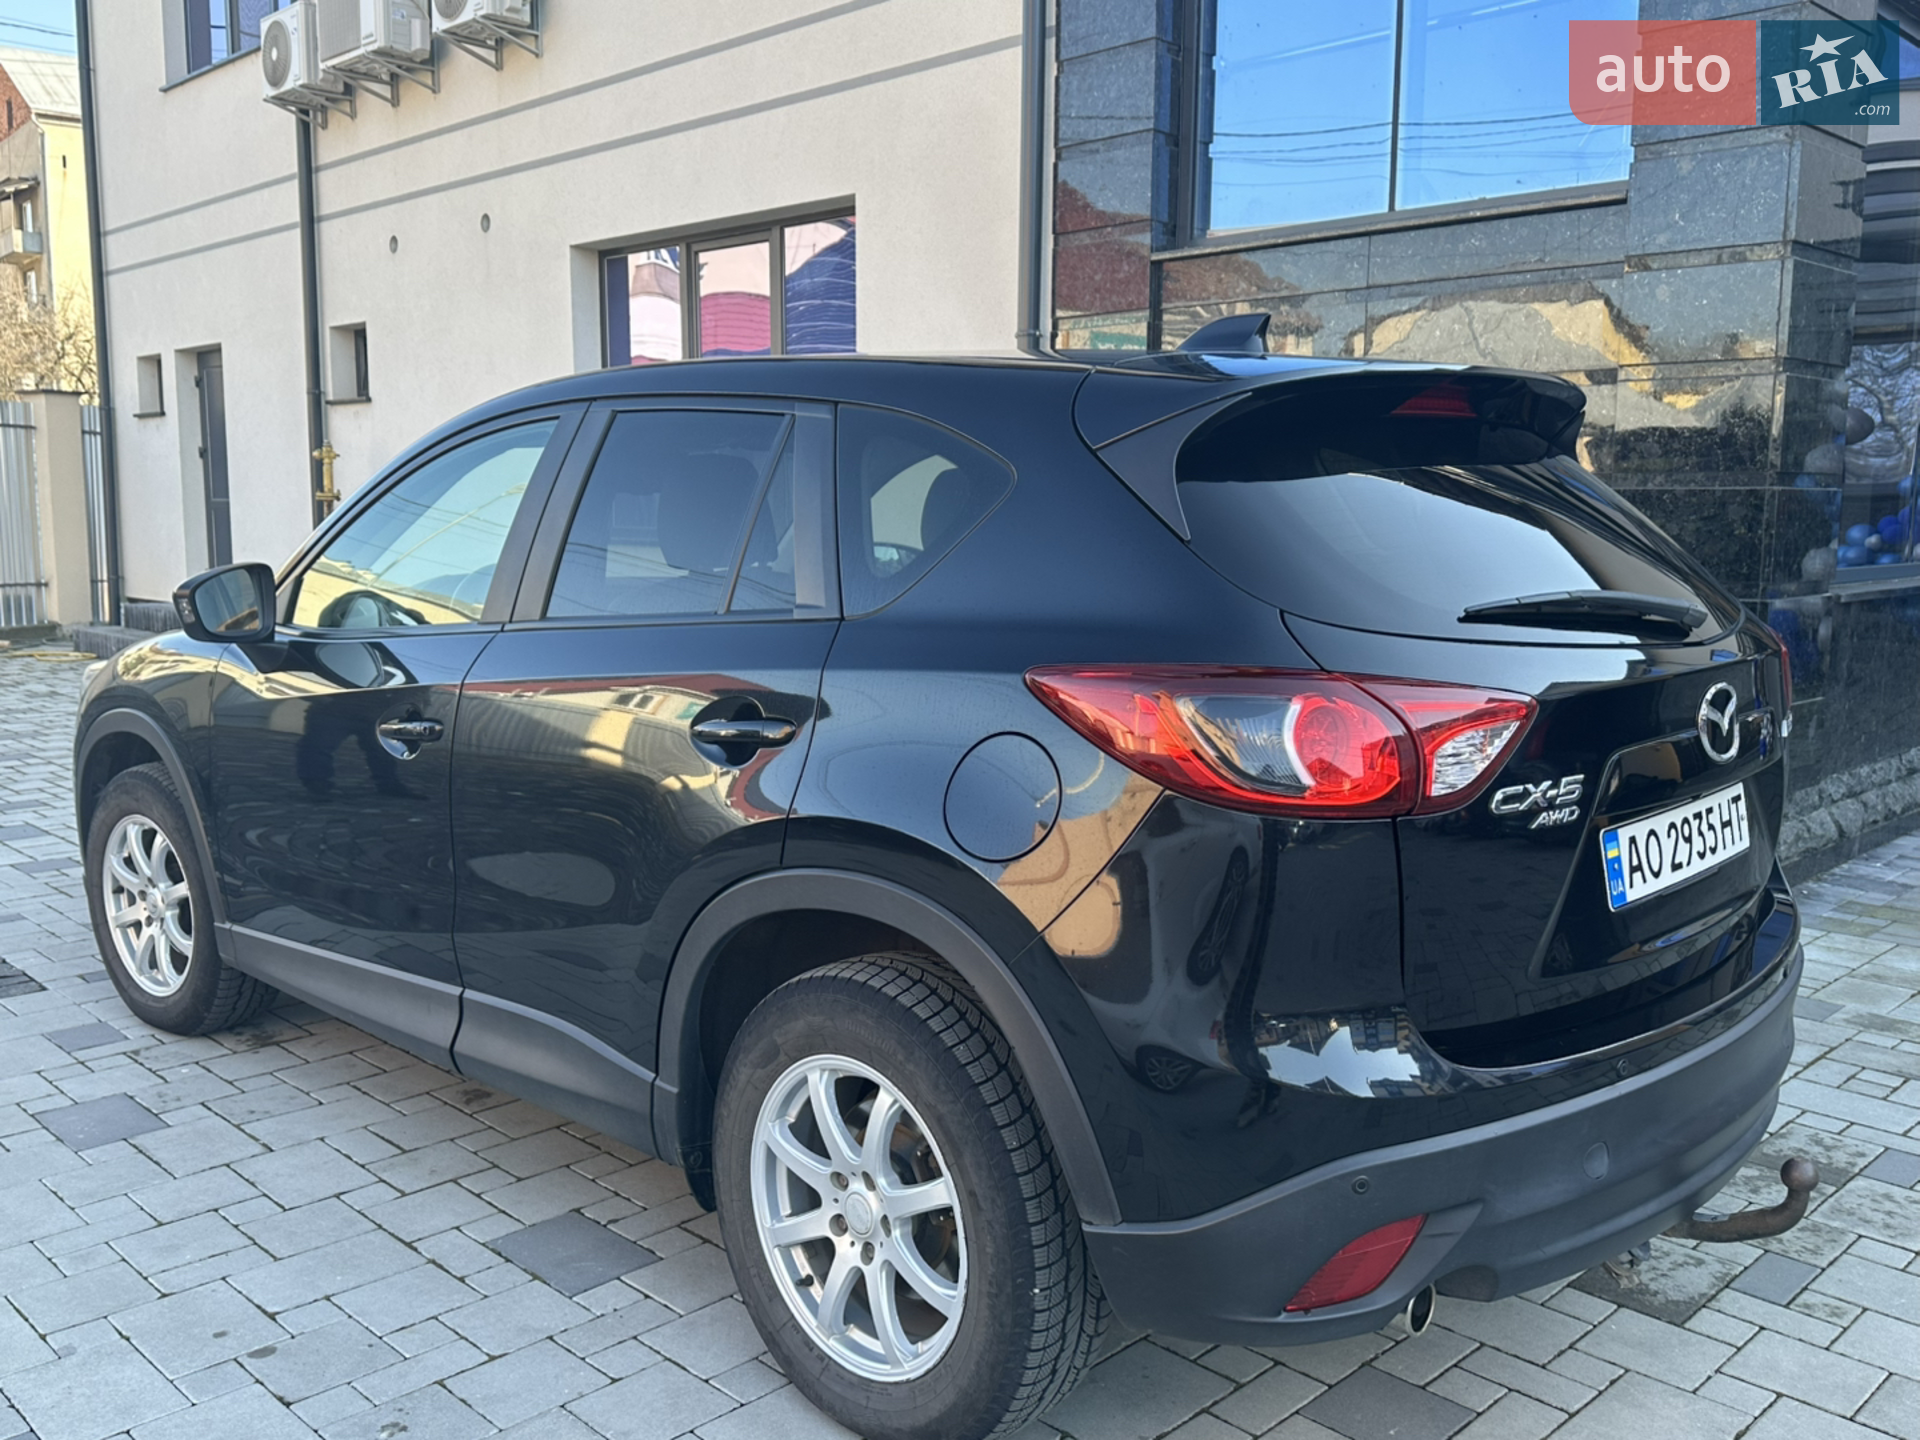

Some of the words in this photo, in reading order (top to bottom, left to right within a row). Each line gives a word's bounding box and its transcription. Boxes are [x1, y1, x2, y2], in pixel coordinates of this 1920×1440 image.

[1492, 774, 1585, 814] CX-5
[1530, 806, 1580, 829] AWD
[1611, 878, 1625, 895] UA
